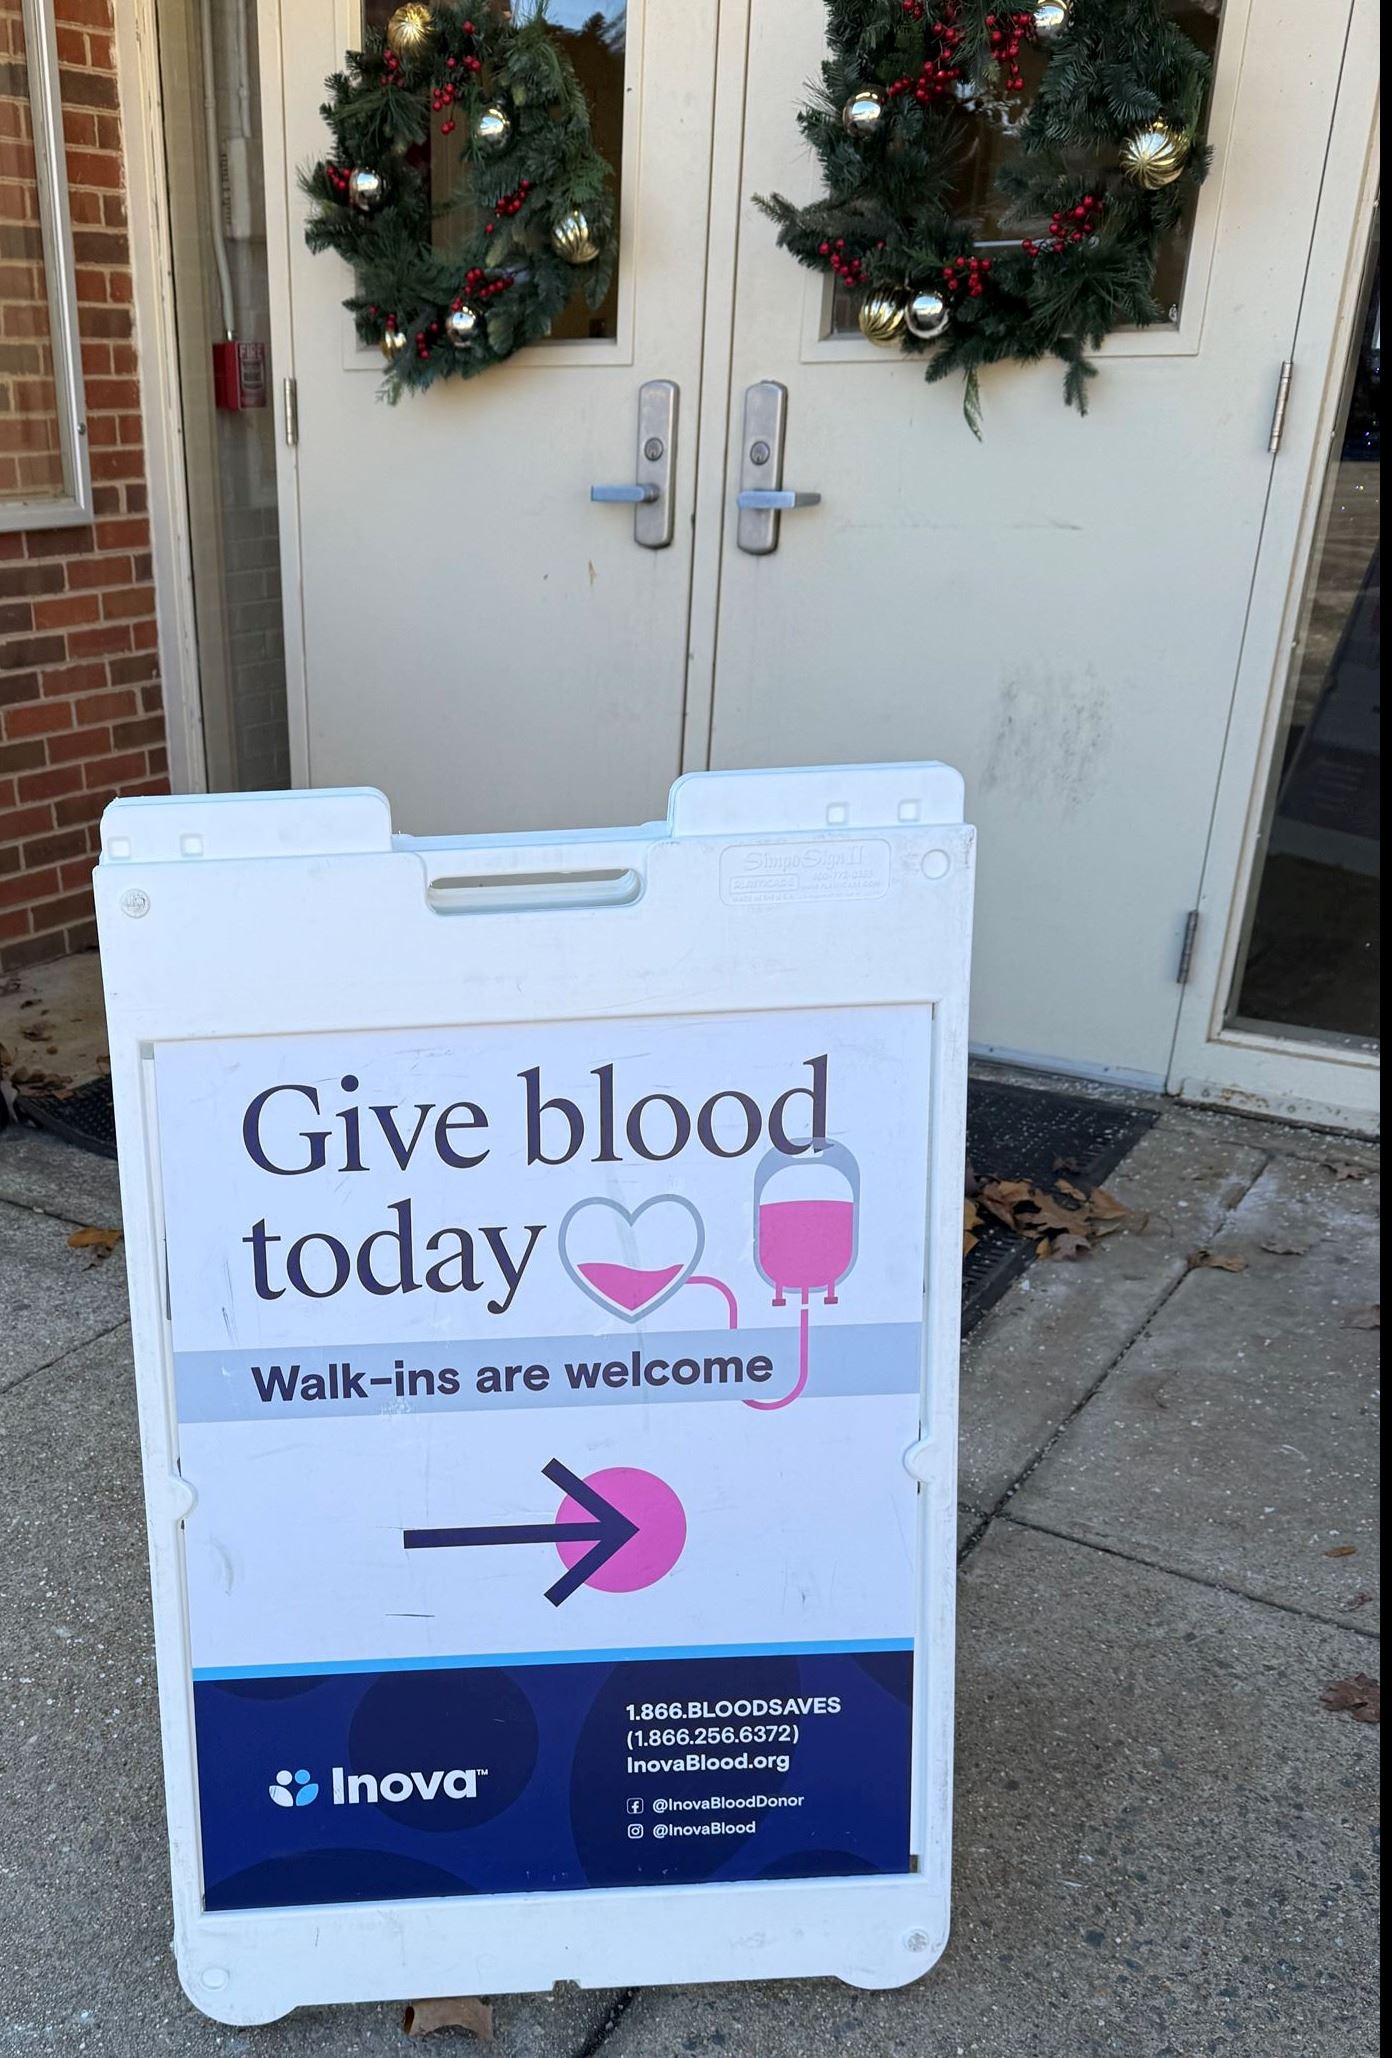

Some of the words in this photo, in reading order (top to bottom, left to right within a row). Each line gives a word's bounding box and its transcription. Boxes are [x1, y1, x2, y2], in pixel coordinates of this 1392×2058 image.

[243, 1075, 490, 1175] Give
[517, 1054, 829, 1165] blood
[243, 1198, 546, 1314] today
[251, 1360, 460, 1402] Walk-ins
[476, 1365, 549, 1393] are
[565, 1351, 774, 1389] welcome
[627, 1697, 842, 1721] 1.866.BLOODSAVES
[627, 1725, 799, 1750] (1.866.256.6372)
[627, 1753, 790, 1774] InovaBlood.org
[653, 1796, 805, 1814] @InovaBloodDonor
[653, 1821, 756, 1839] @InovaBlood
